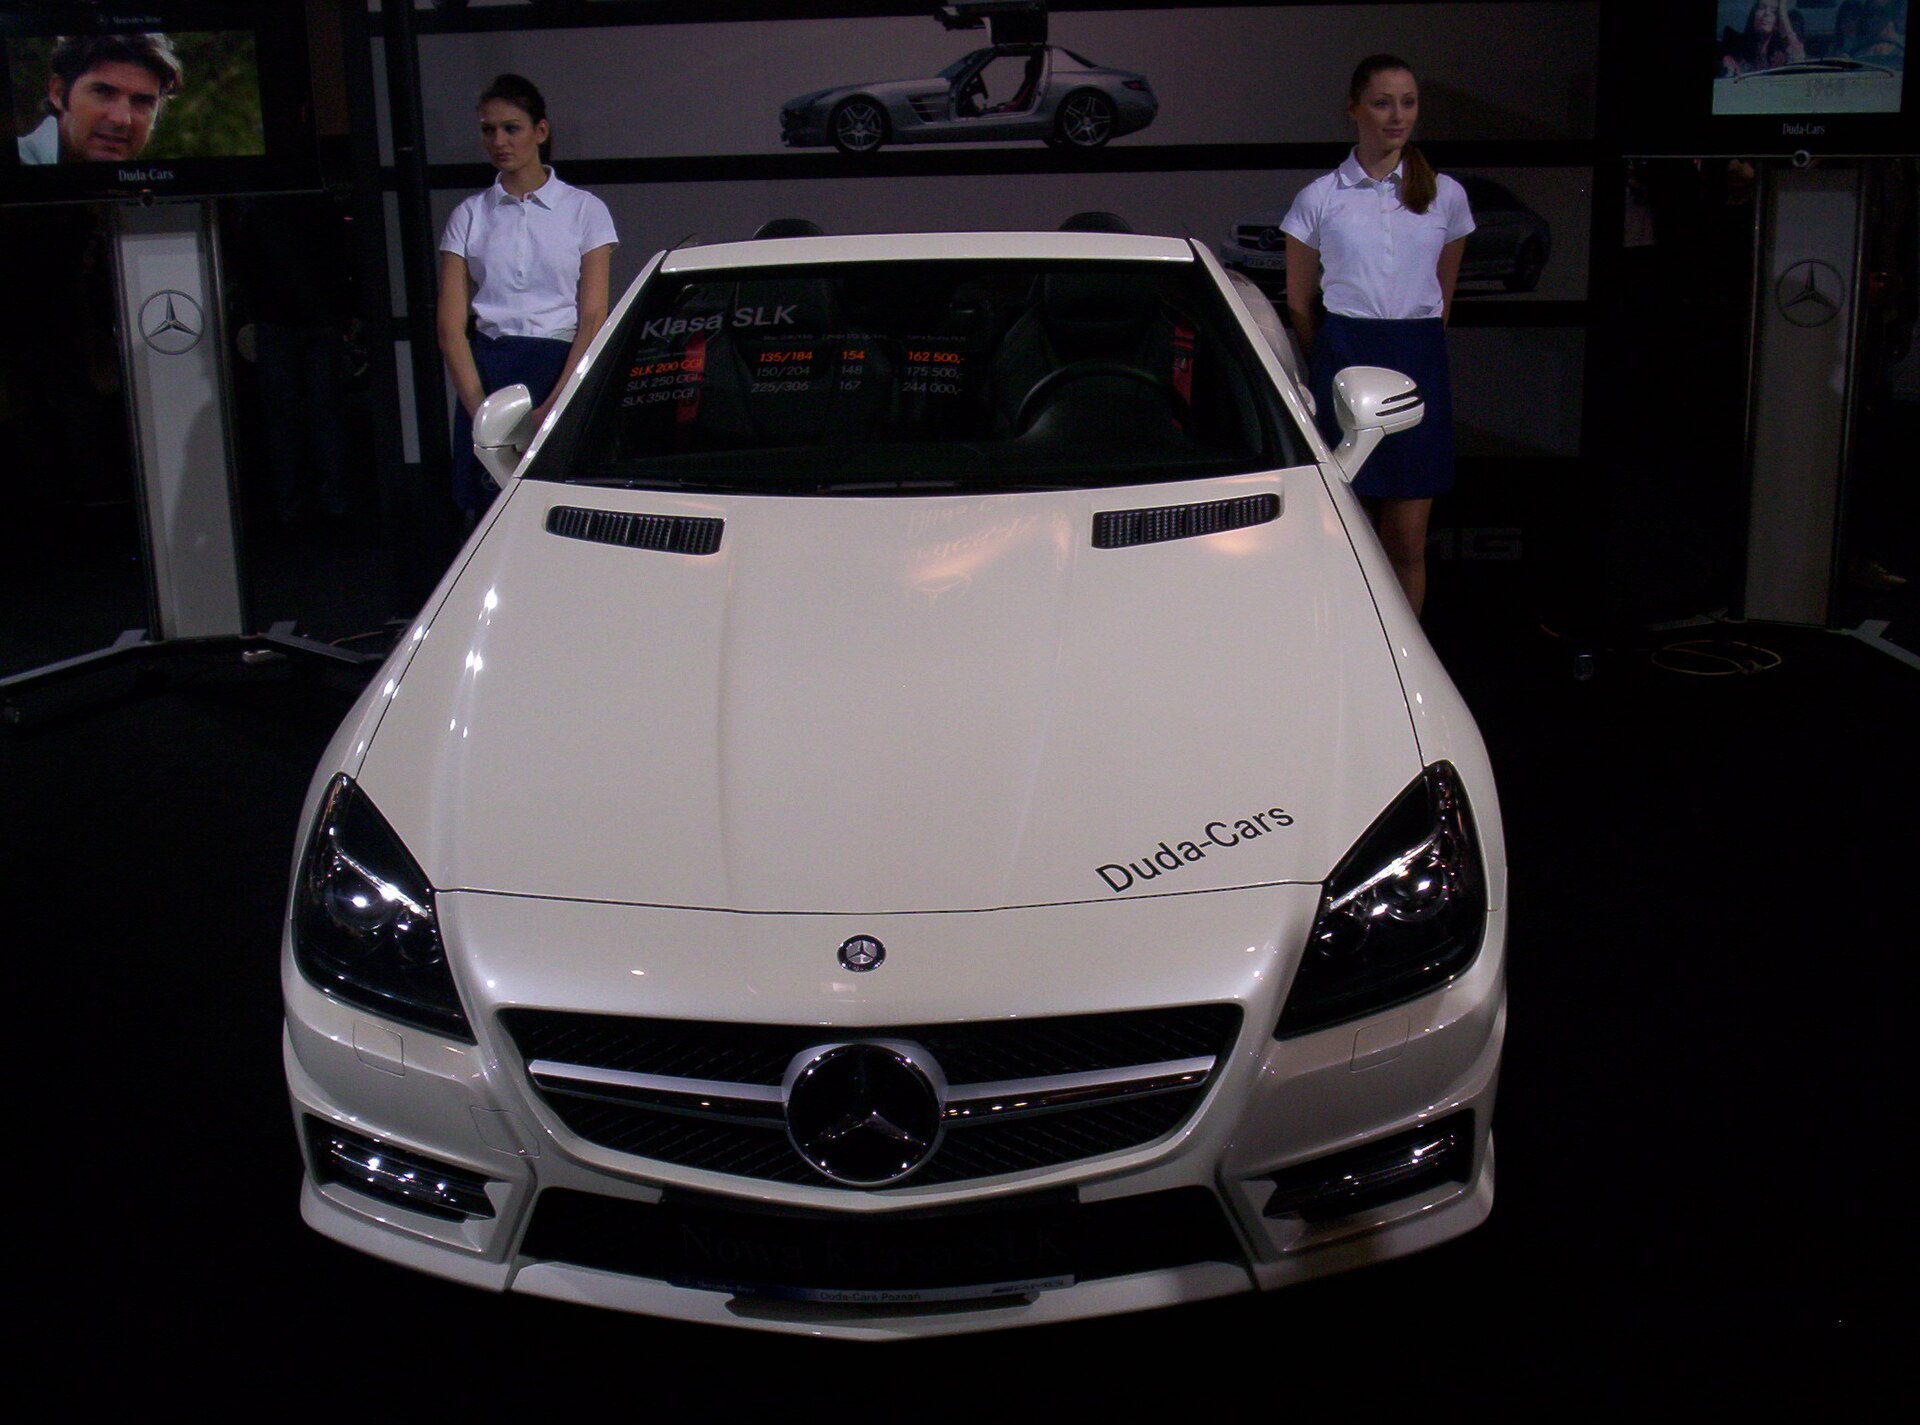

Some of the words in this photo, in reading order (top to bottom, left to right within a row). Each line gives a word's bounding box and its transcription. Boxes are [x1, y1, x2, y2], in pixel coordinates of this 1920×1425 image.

[1782, 122, 1825, 135] Duda-Cars
[118, 168, 176, 182] Duda-Cars
[640, 314, 724, 341] Klasa
[732, 304, 798, 328] SLK
[759, 351, 813, 363] 135/184
[841, 350, 865, 361] 154
[906, 351, 929, 362] 162
[629, 364, 655, 377] SLK
[655, 360, 679, 373] 200
[756, 366, 810, 377] 150/204
[626, 380, 648, 391] SLK
[622, 395, 646, 407] SLK
[672, 387, 695, 399] CGI
[1095, 806, 1294, 893] Duda-Cars
